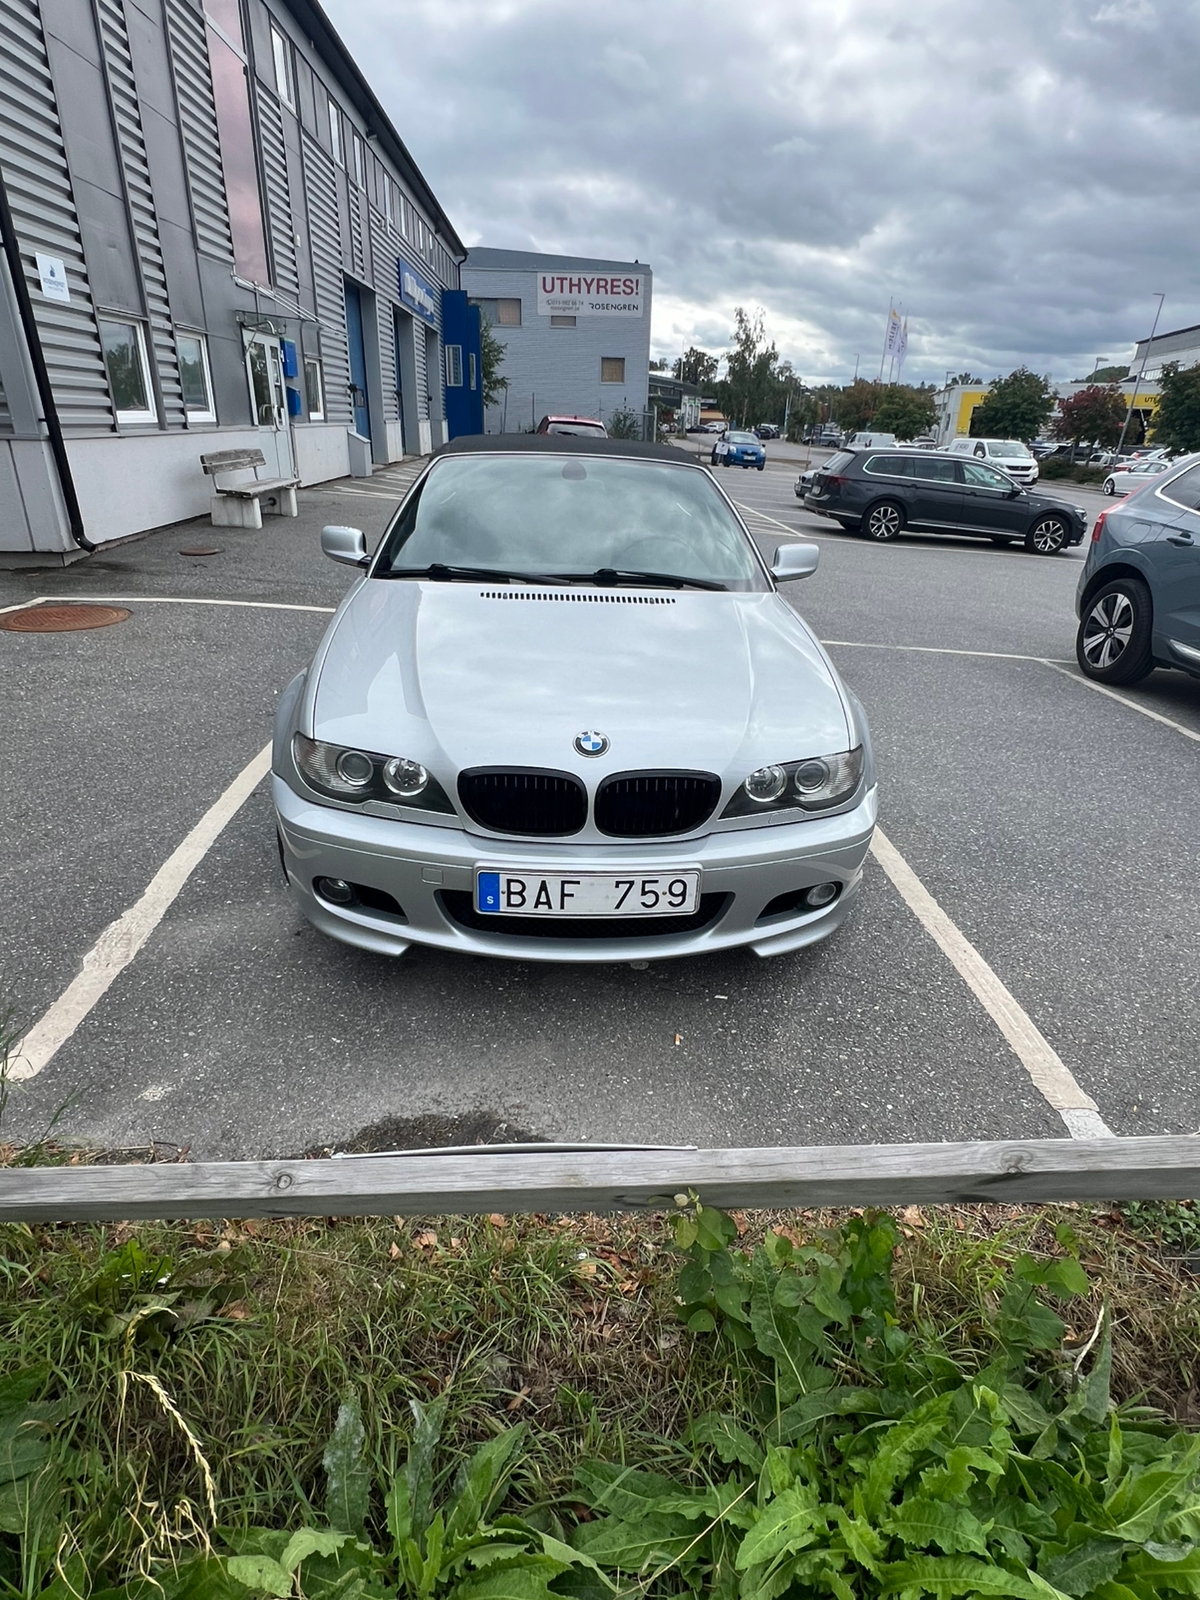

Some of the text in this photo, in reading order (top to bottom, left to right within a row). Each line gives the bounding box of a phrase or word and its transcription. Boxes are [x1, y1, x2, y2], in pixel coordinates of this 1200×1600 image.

[542, 276, 639, 296] UTHYRES!
[588, 302, 639, 311] ROSENGREN
[486, 895, 494, 905] S
[506, 878, 688, 910] BAF 759
